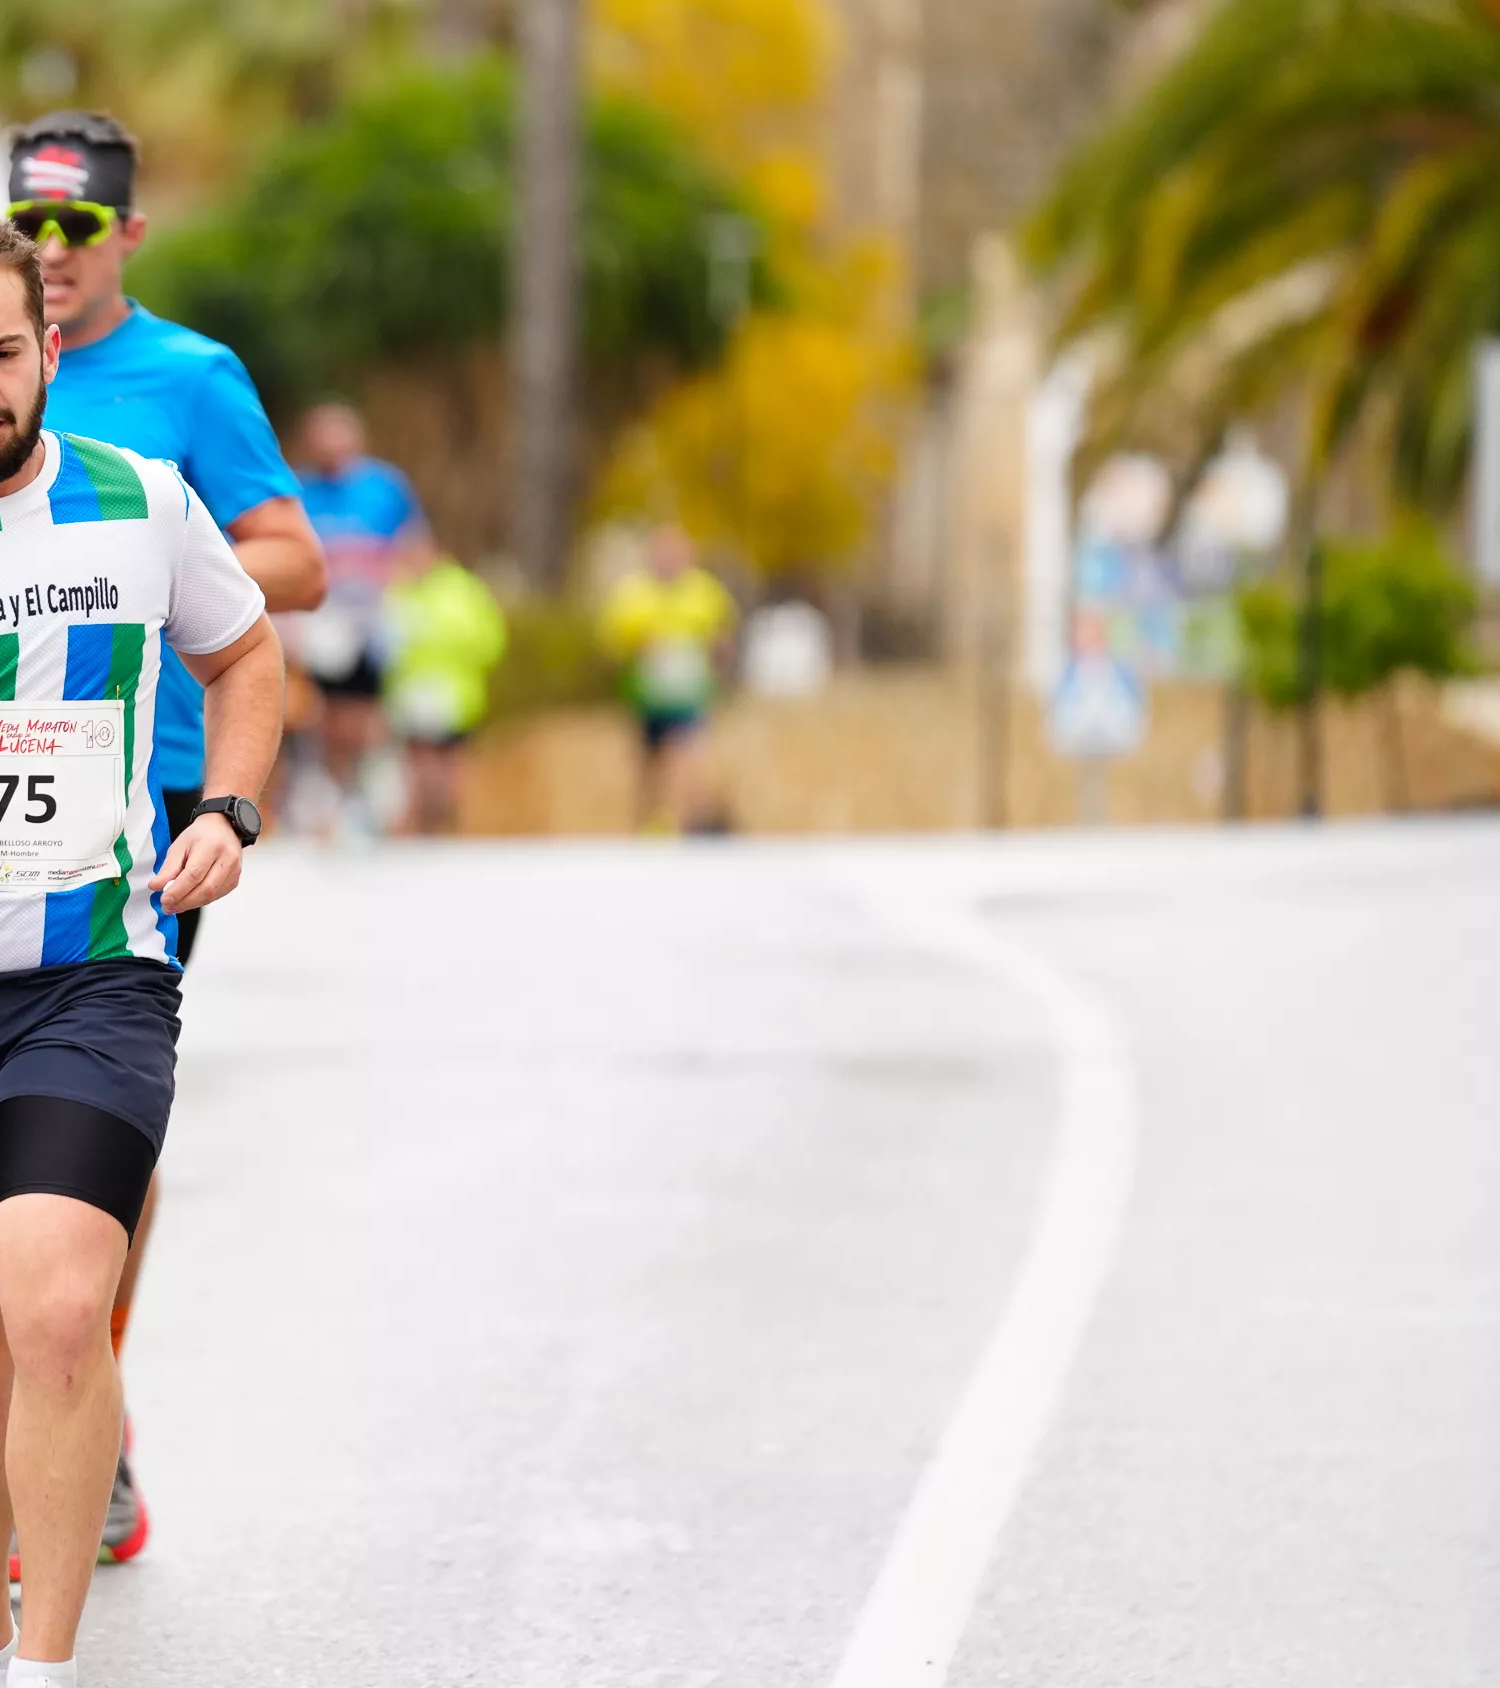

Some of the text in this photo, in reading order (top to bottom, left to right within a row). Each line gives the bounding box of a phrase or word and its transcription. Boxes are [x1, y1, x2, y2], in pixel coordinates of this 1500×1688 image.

[9, 594, 20, 627] y
[25, 584, 43, 616] El
[47, 576, 119, 617] Campillo
